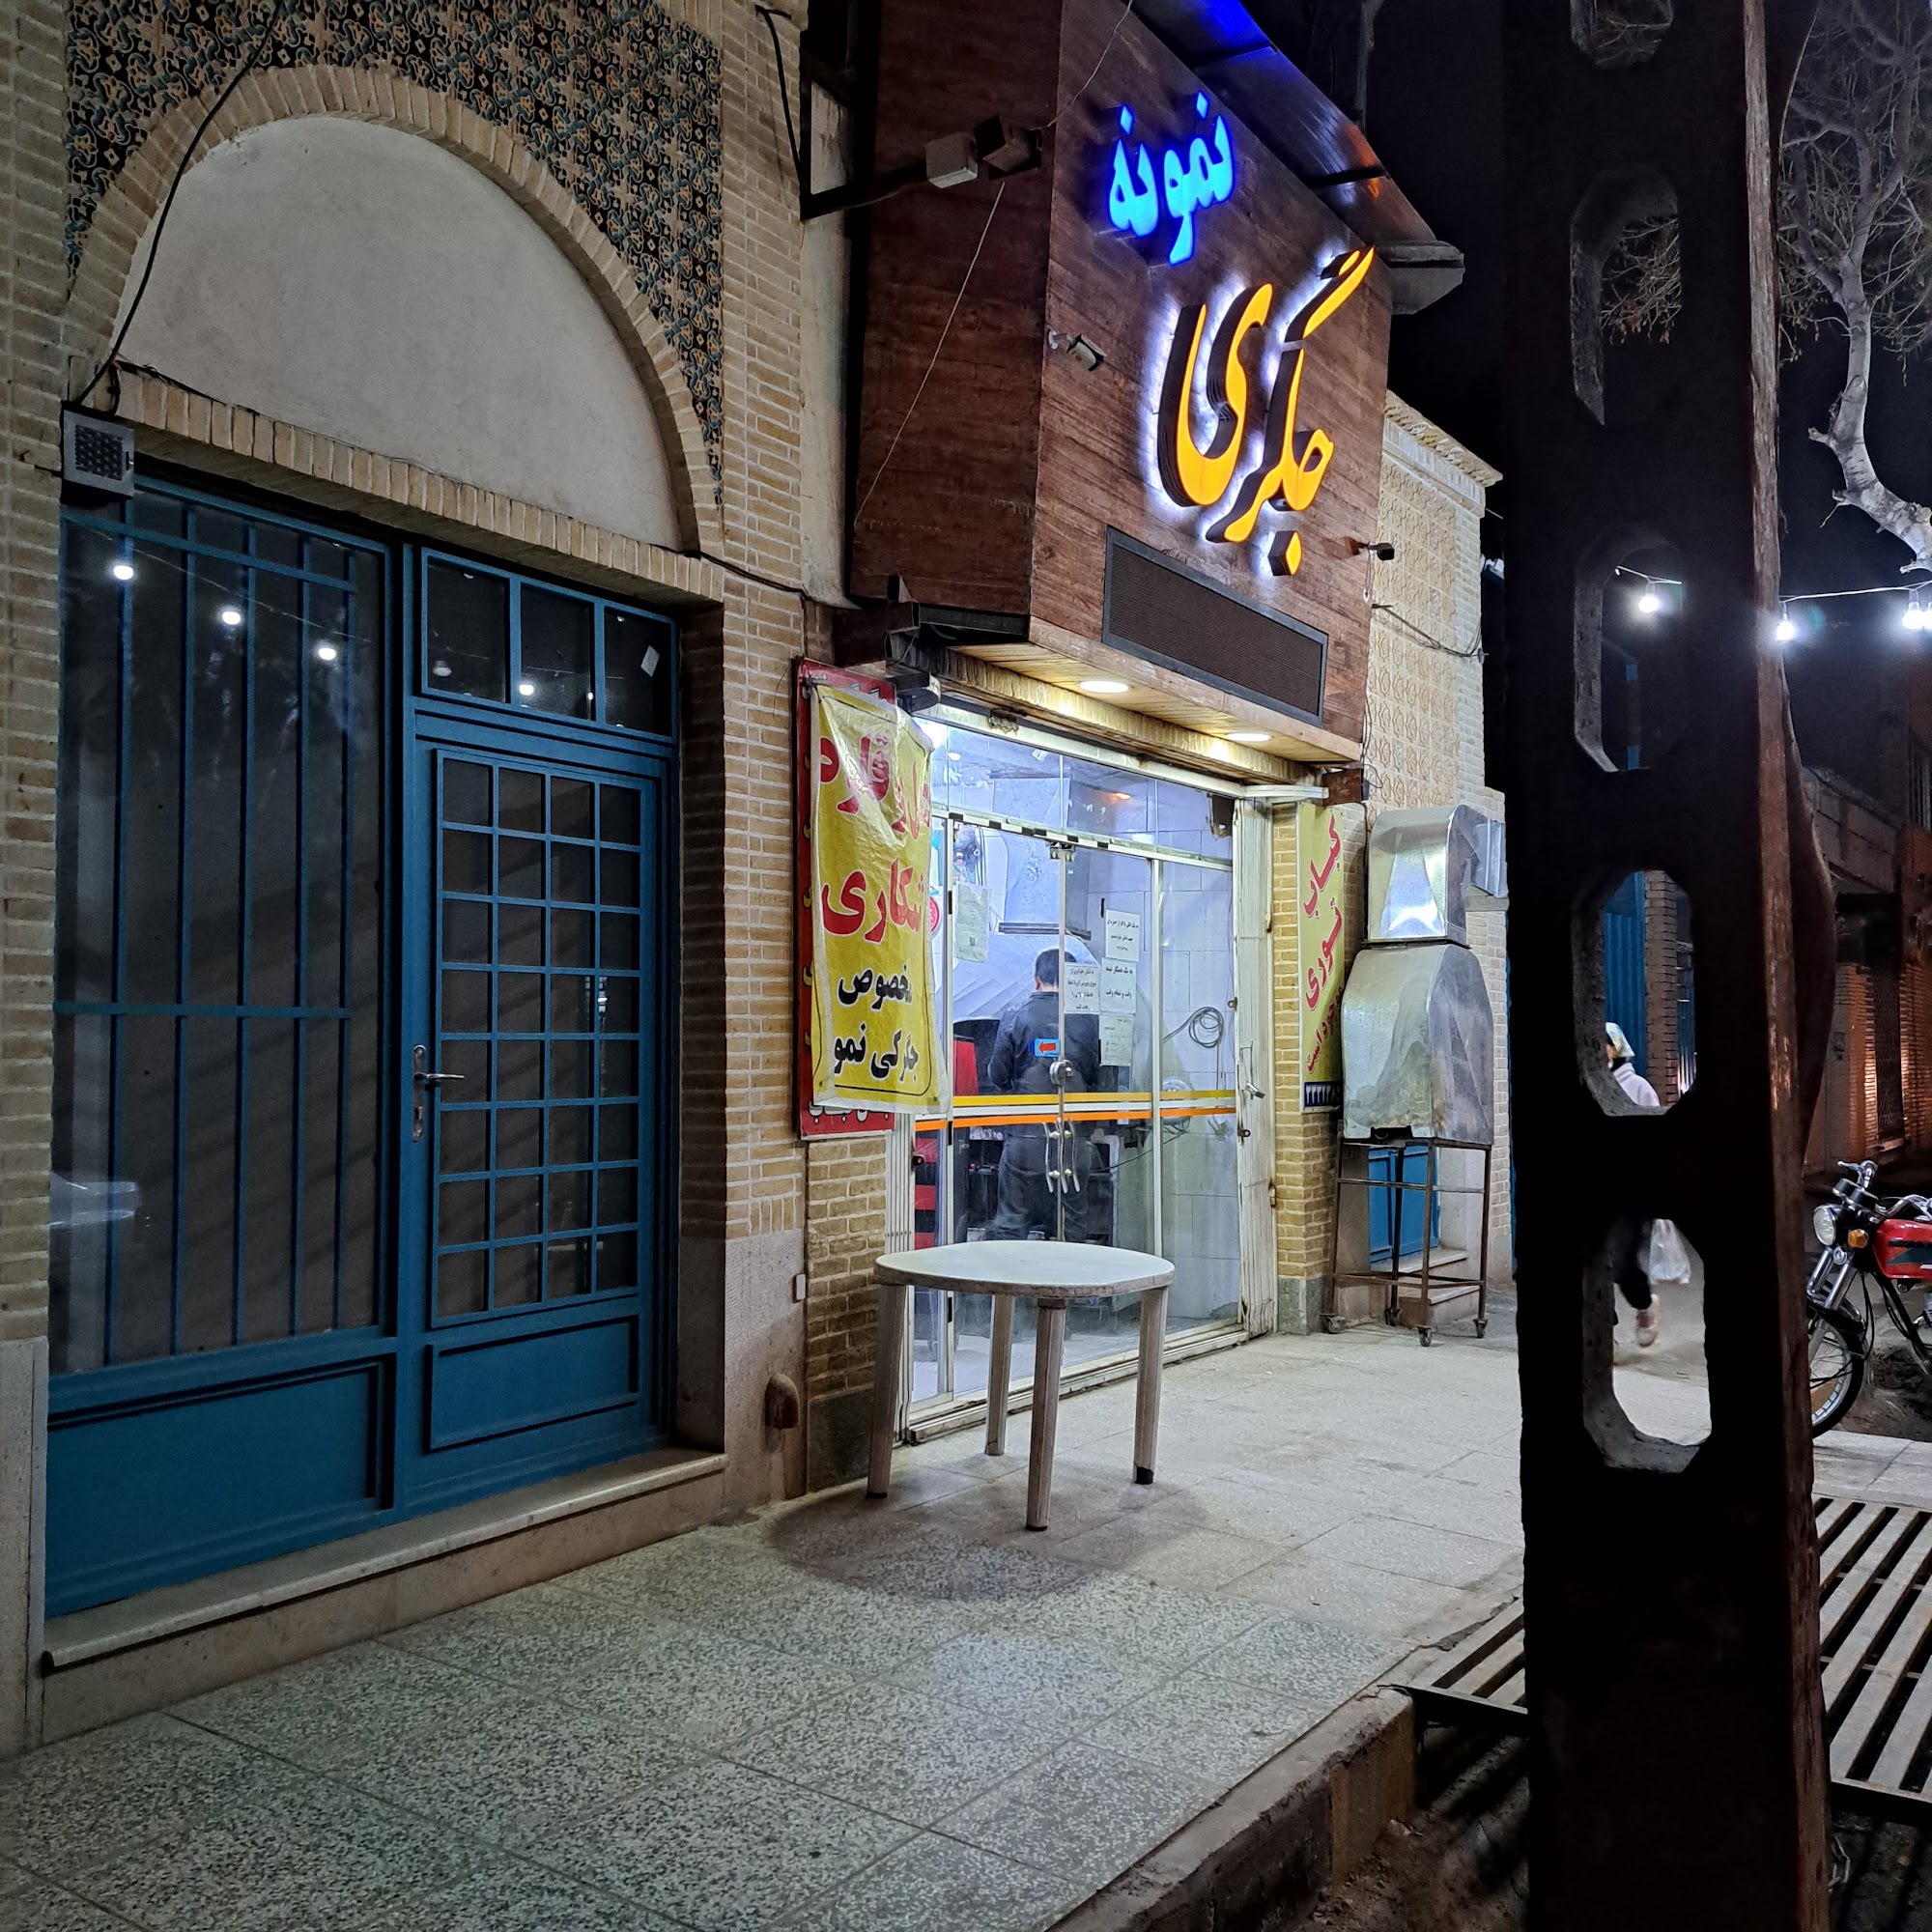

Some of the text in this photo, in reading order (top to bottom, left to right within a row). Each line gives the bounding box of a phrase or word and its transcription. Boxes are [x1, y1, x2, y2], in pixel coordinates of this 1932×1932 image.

[1109, 91, 1235, 266] نمونه
[820, 856, 924, 945] شکاری
[1304, 812, 1342, 918] کباب
[834, 1021, 867, 1075] نمو
